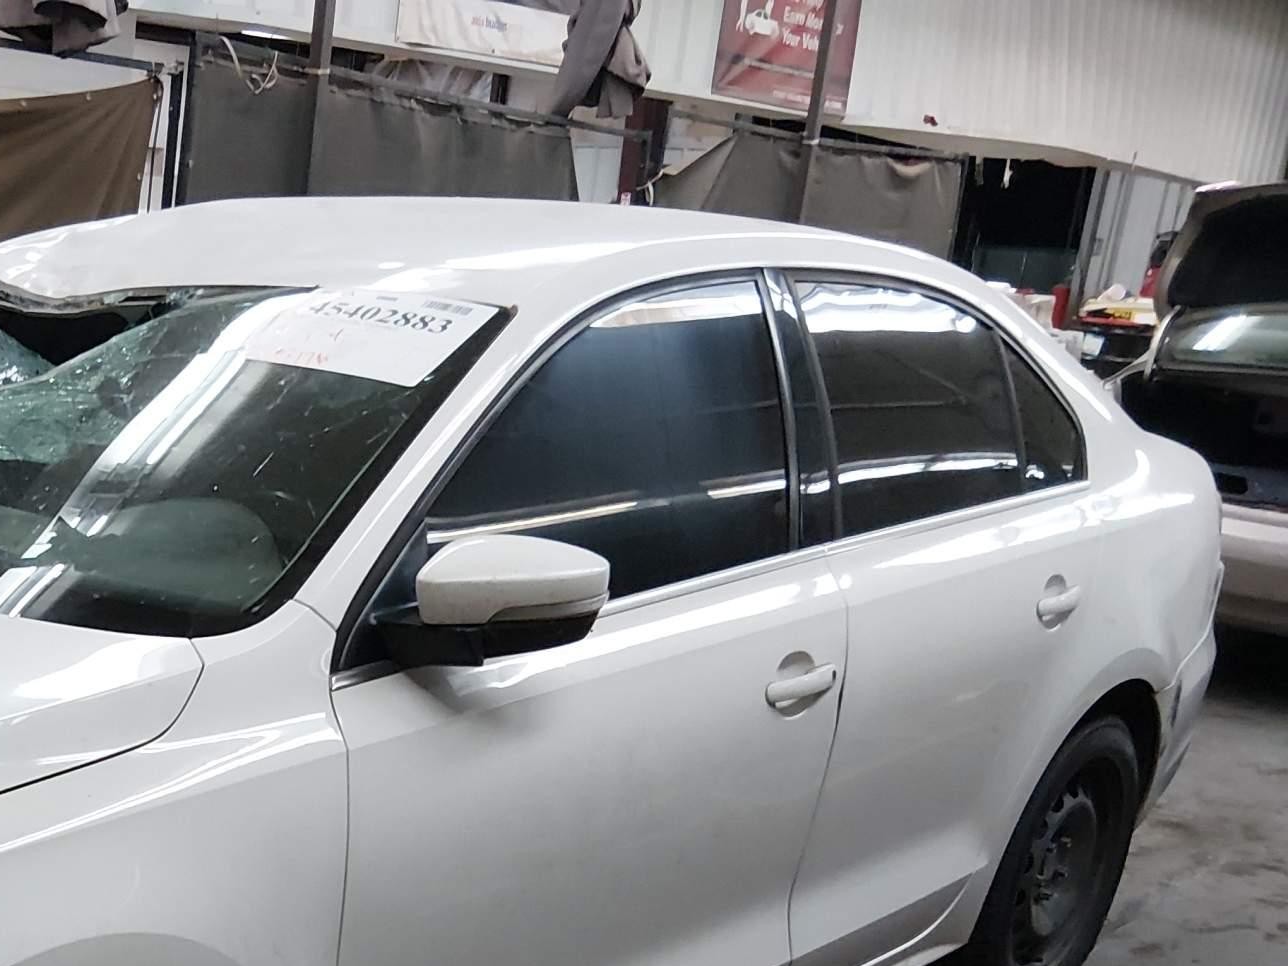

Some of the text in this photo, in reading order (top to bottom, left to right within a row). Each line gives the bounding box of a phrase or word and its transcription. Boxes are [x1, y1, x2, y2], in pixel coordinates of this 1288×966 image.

[783, 5, 805, 25] Earn
[782, 25, 801, 47] Your
[309, 301, 453, 333] 45402883
